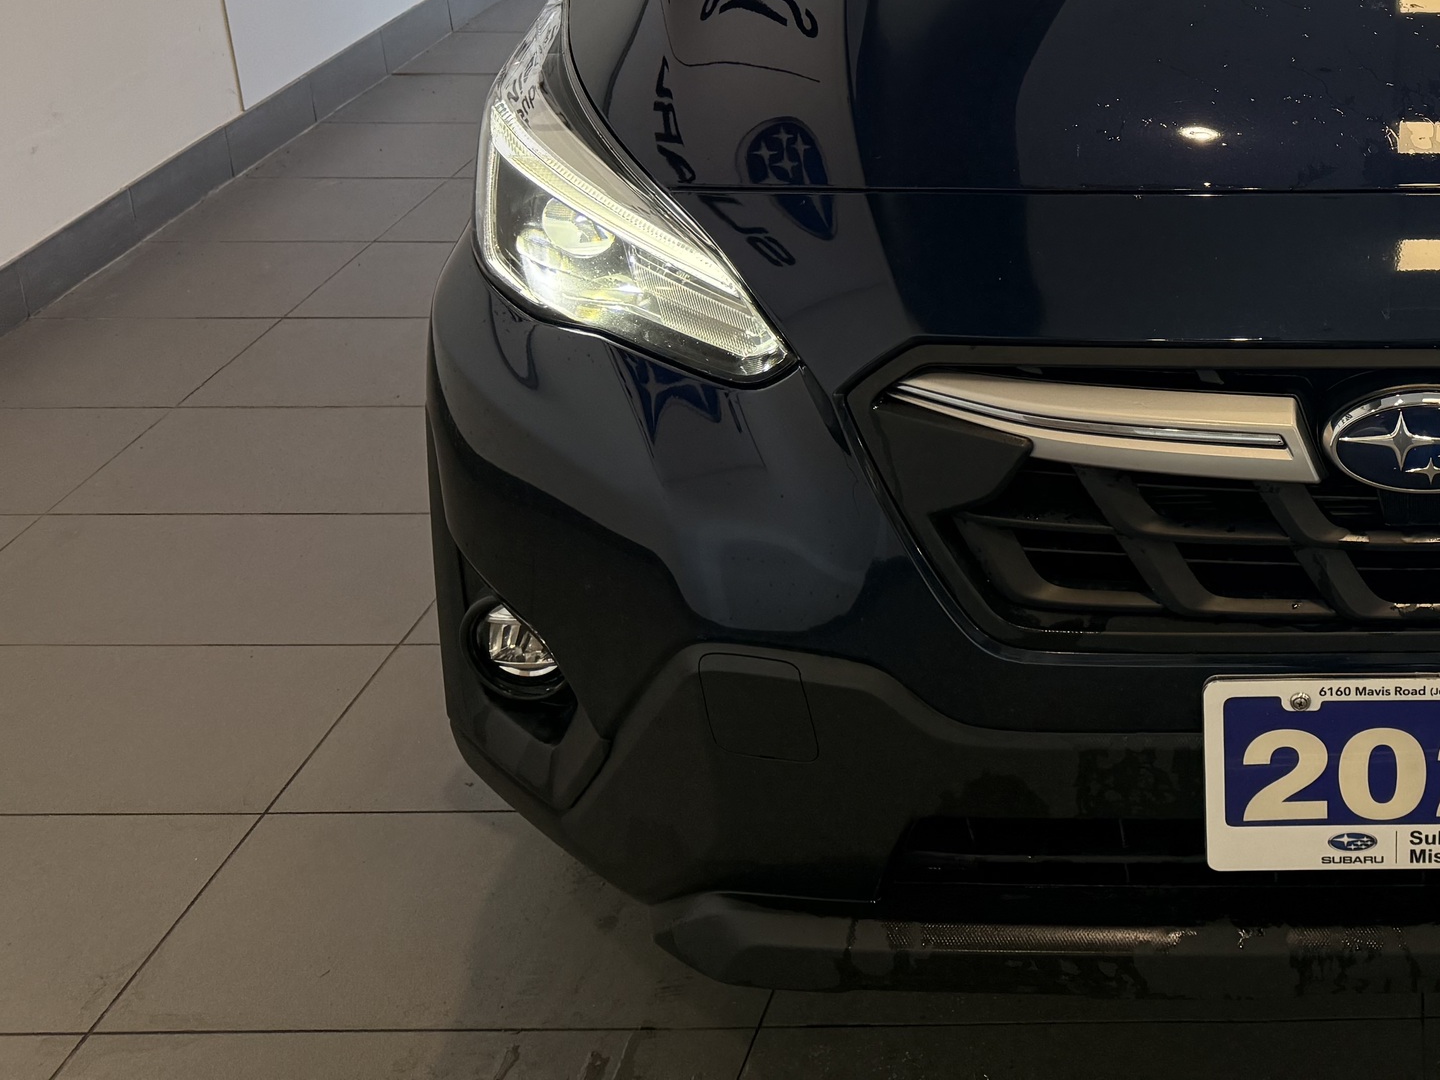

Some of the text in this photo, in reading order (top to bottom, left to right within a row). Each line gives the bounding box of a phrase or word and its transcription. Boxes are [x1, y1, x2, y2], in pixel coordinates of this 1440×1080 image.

[1318, 686, 1351, 697] 6160
[1355, 686, 1391, 696] Mavis
[1394, 685, 1426, 696] Road
[1321, 855, 1384, 865] SUBARU
